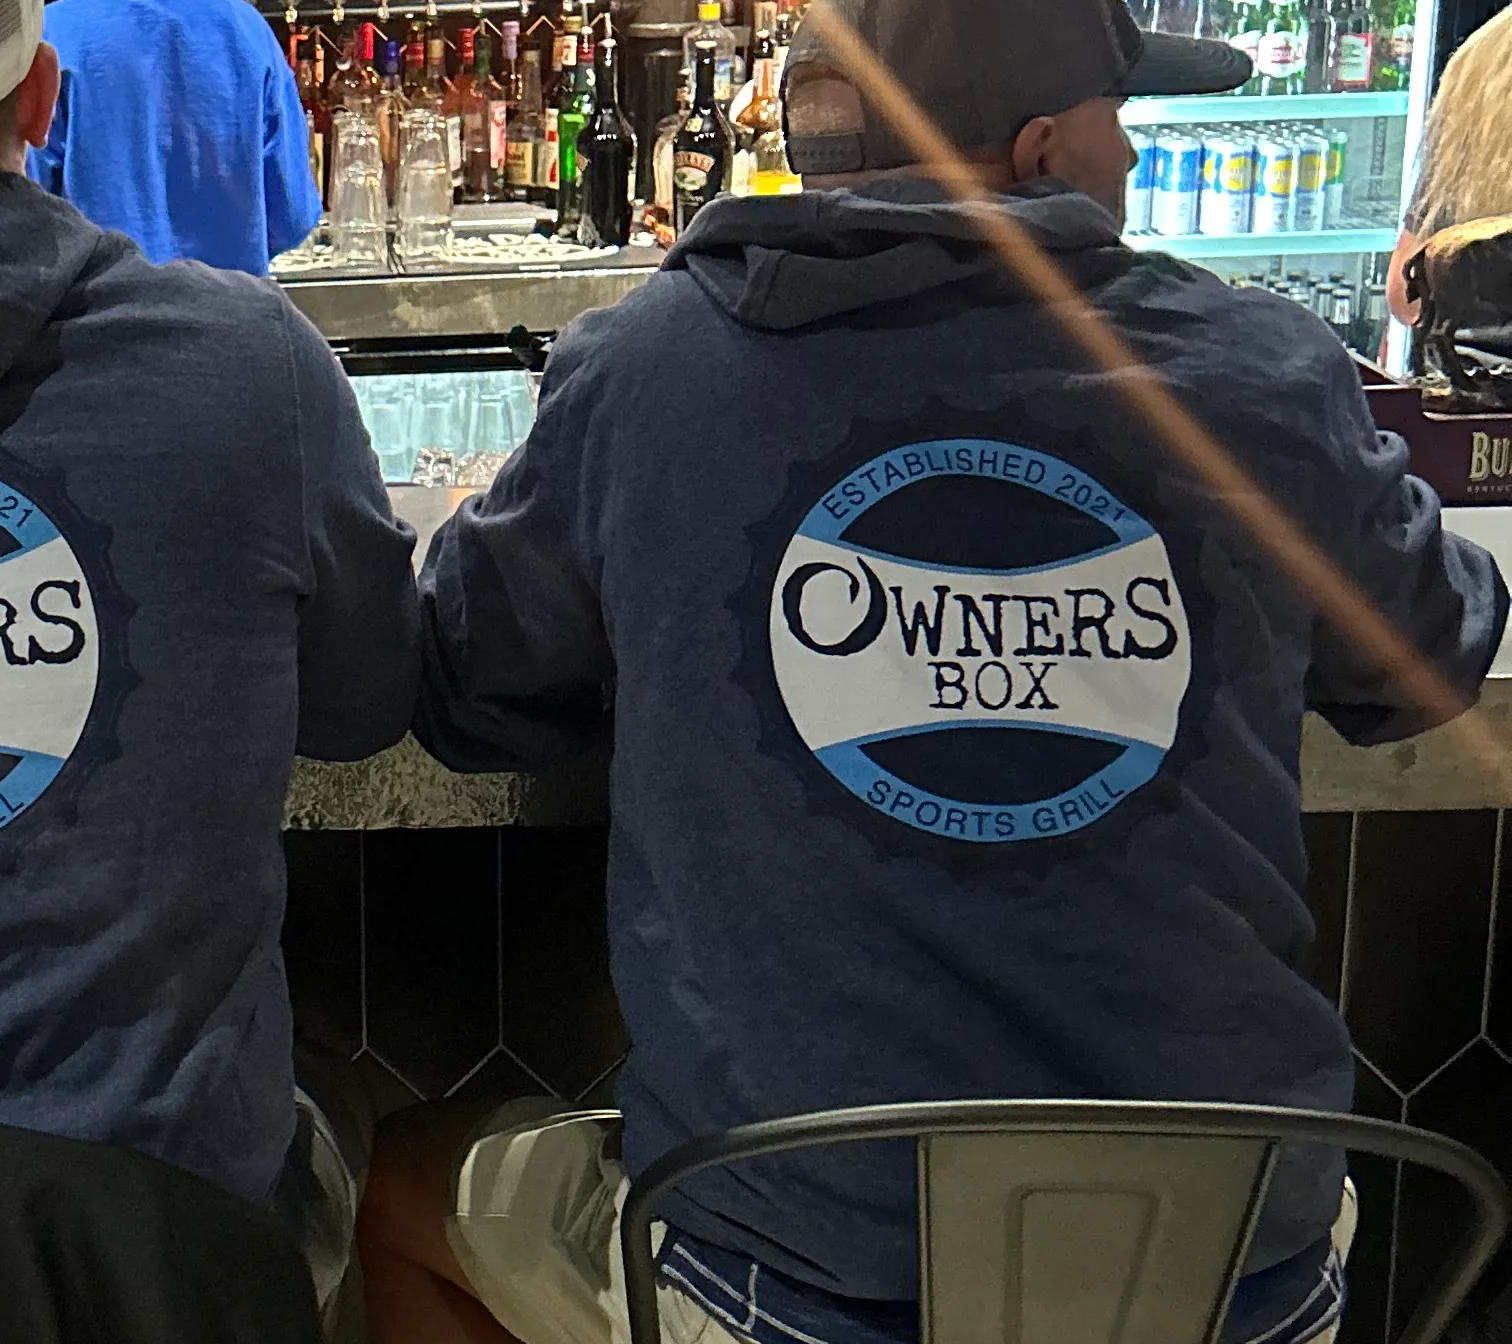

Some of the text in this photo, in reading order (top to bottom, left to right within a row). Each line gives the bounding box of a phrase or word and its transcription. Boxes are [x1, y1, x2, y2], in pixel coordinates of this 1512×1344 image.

[821, 447, 1128, 523] ESTABLISHED 2021
[781, 556, 1178, 660] OWNERS
[927, 661, 1059, 711] BOX
[865, 777, 1126, 838] SPORTS GRILL
